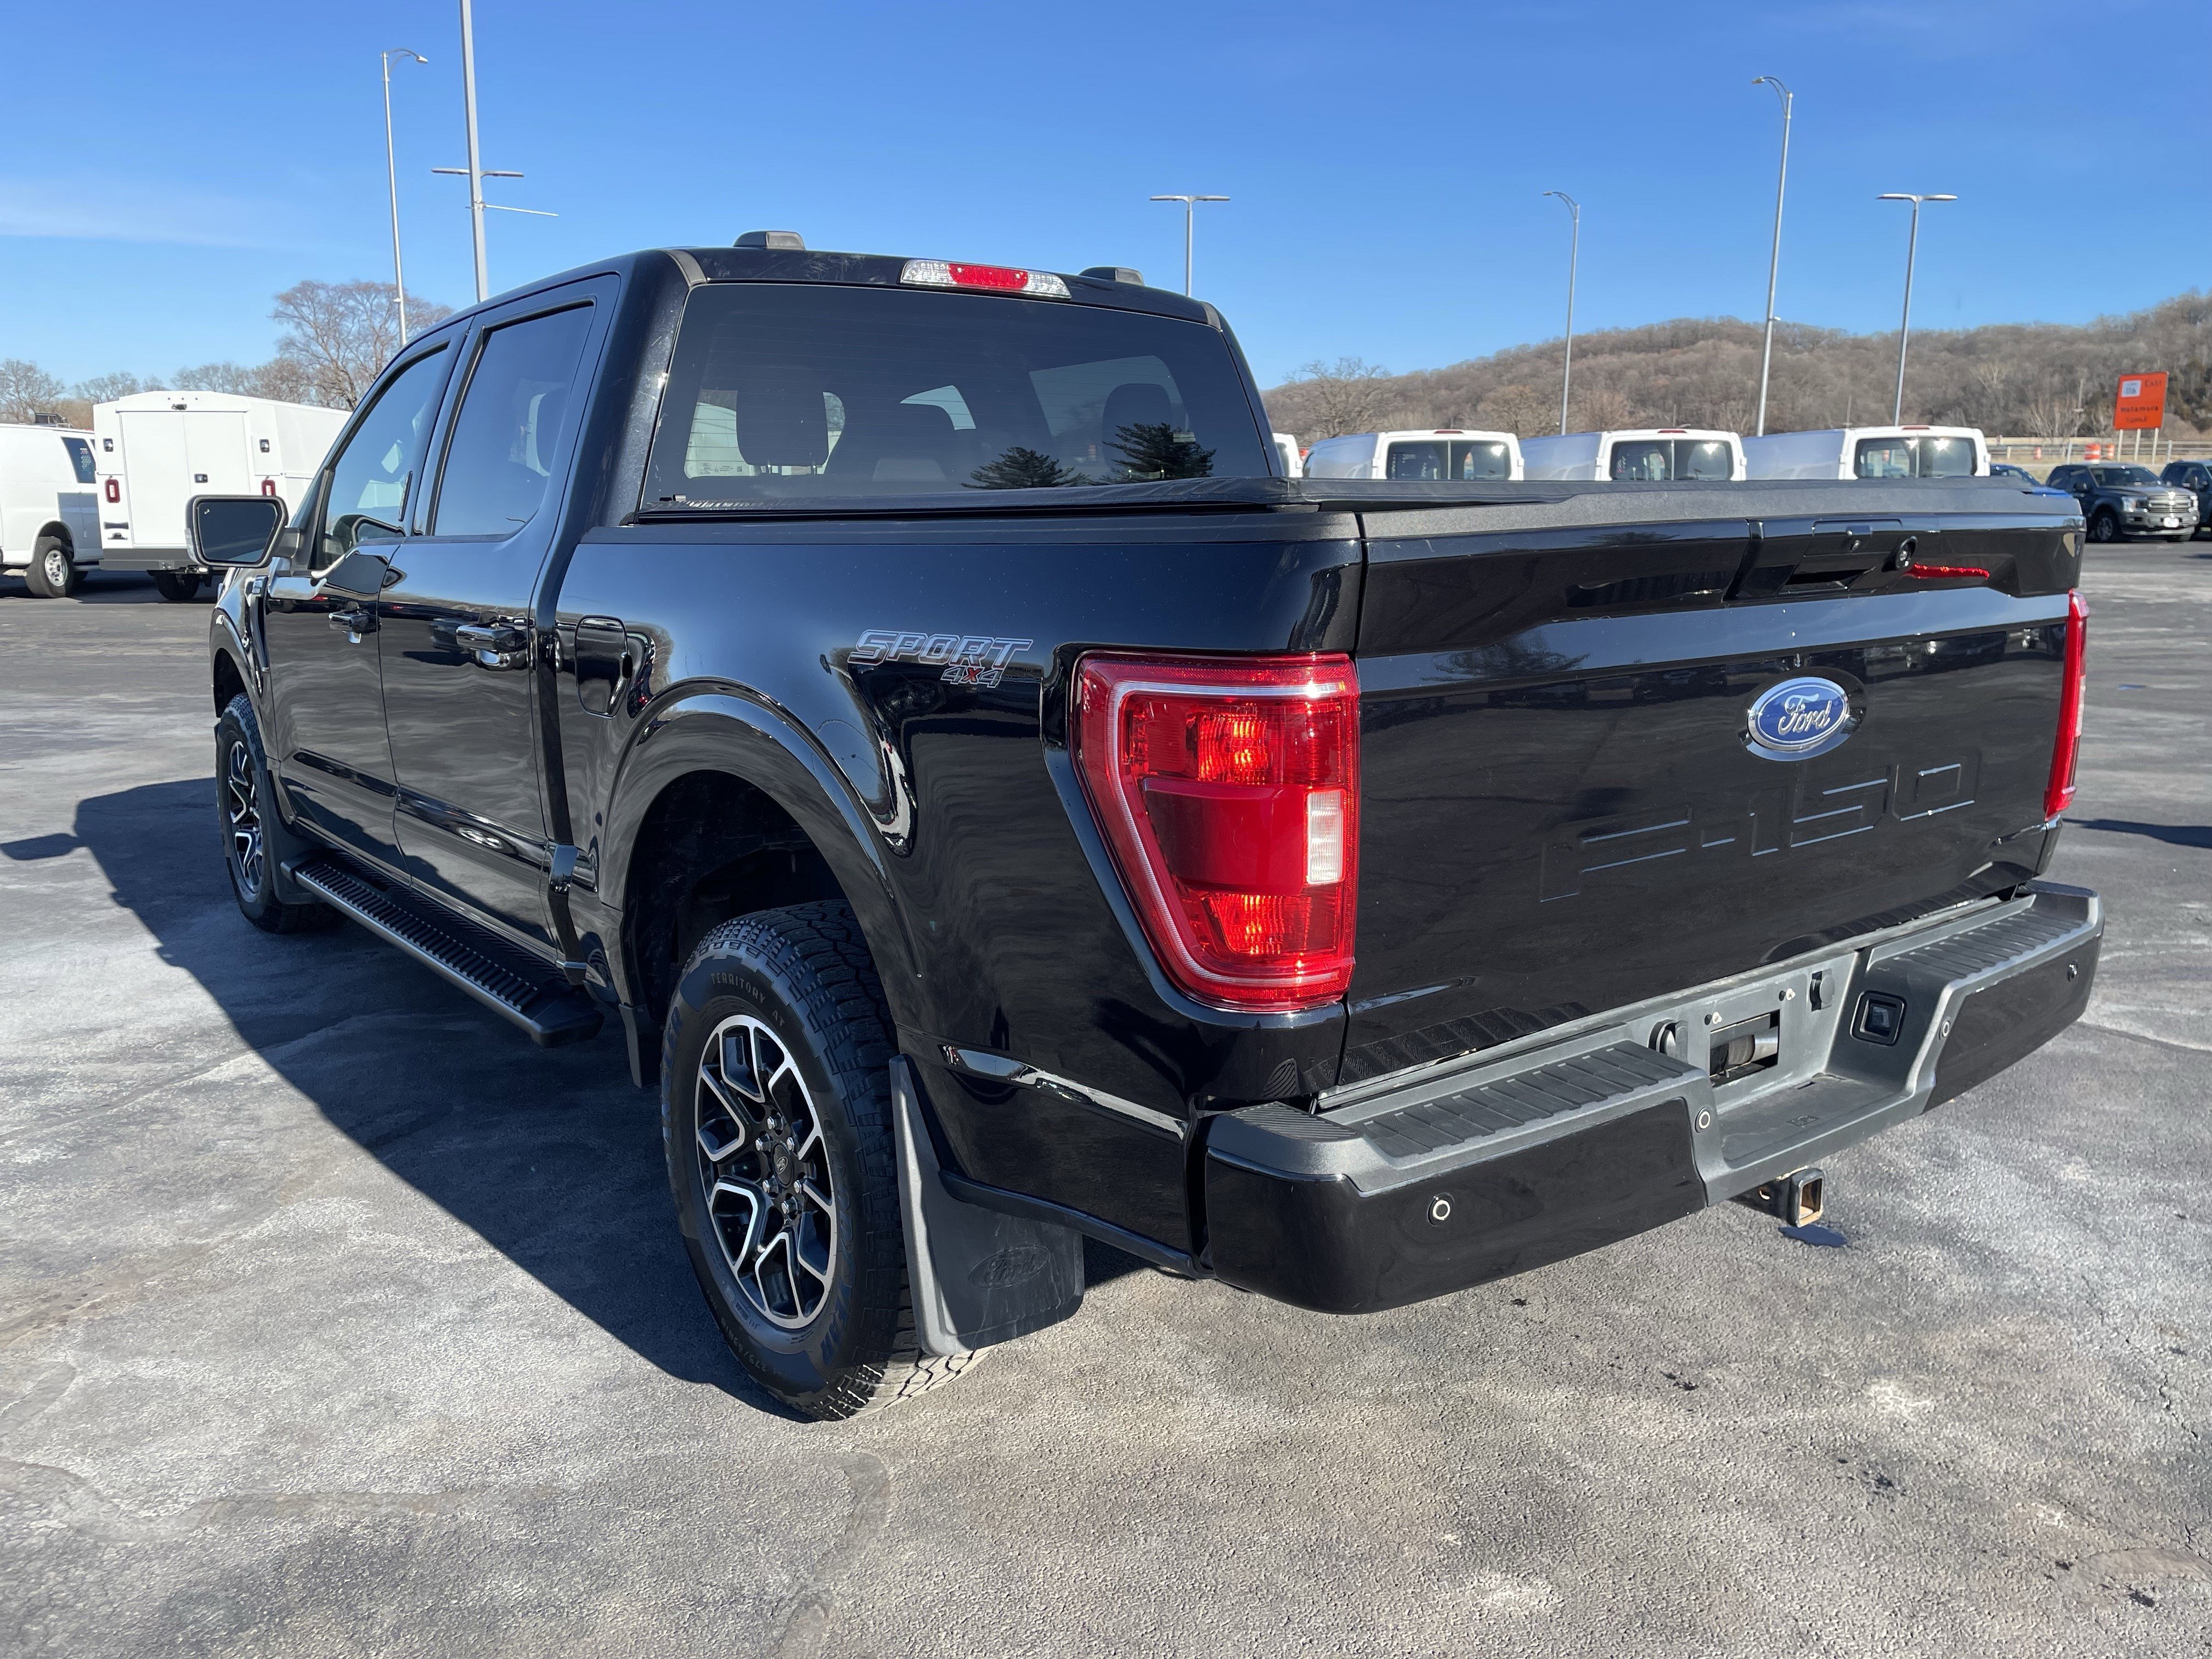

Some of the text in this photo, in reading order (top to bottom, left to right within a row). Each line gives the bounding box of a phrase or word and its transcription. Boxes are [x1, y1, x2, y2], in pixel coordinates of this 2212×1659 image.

[848, 629, 1034, 669] SPORT
[1778, 692, 1832, 736] Ford
[710, 972, 786, 1028] TERRITORY AT
[984, 1254, 1037, 1283] Ford
